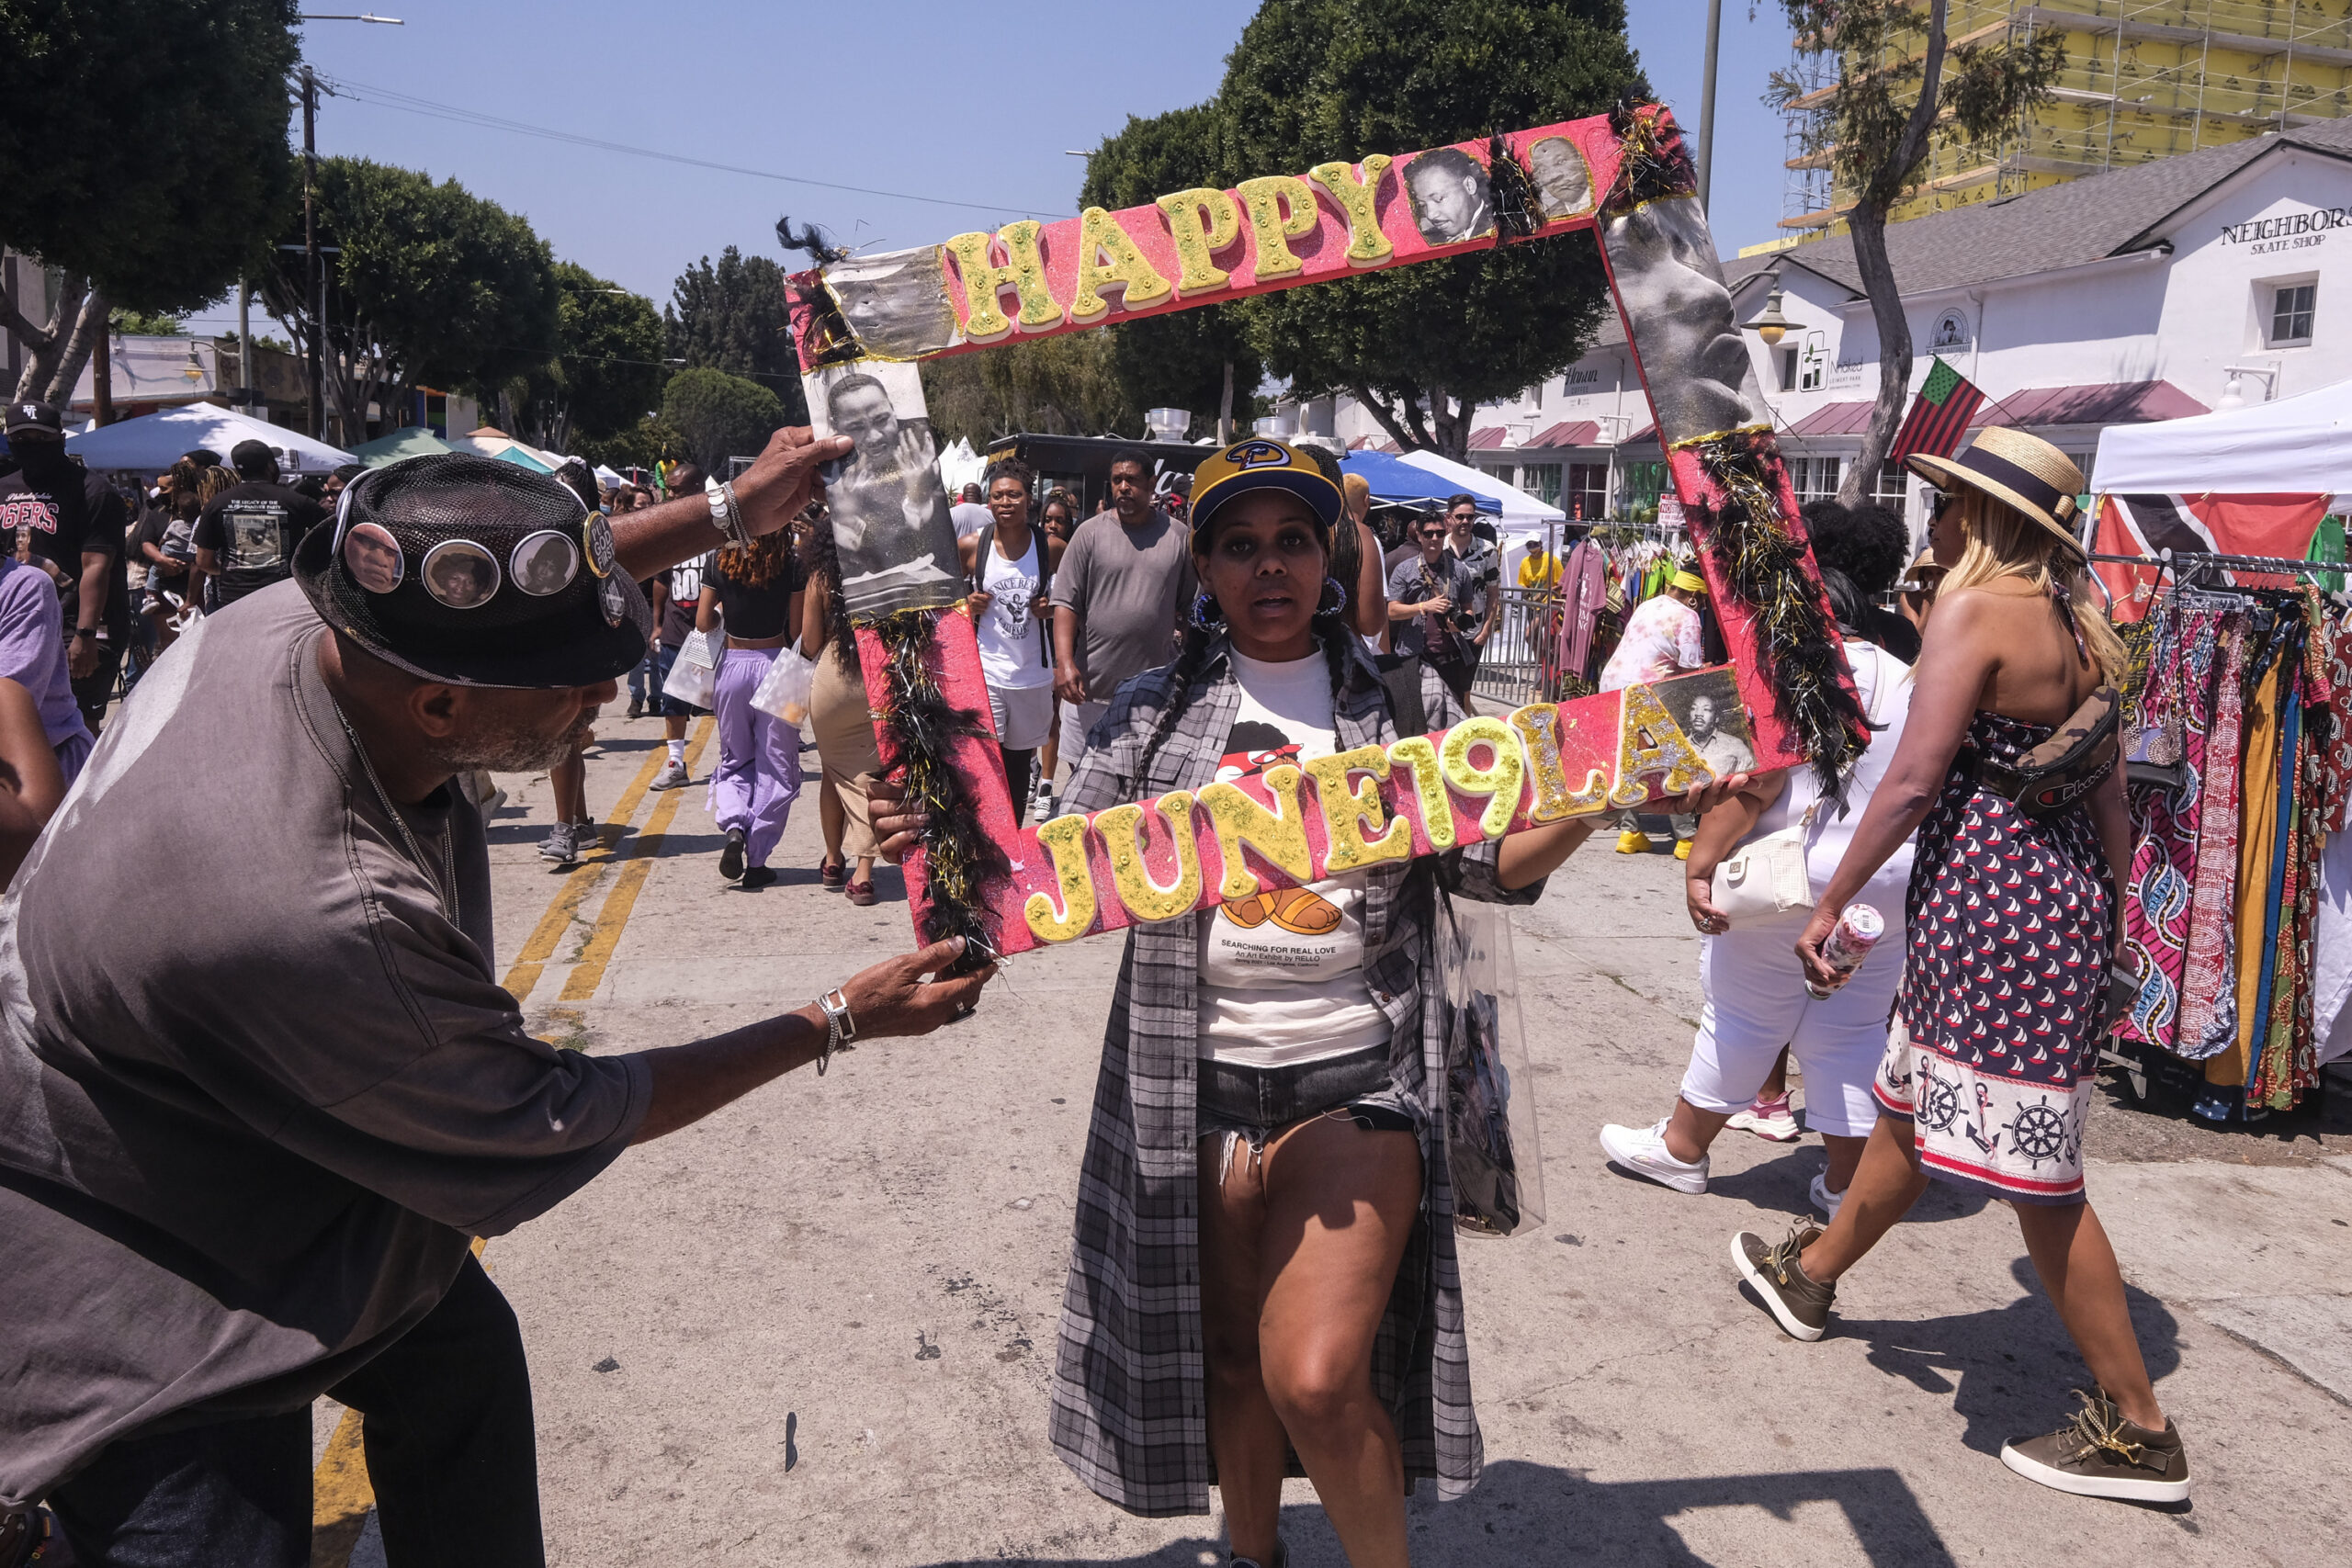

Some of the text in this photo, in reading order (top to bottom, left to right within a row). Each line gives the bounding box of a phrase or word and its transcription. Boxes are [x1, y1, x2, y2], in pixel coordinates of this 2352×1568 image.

[944, 153, 1395, 344] HAPPY
[2250, 234, 2326, 255] SKATE SHOP
[591, 519, 608, 541] PUT
[594, 532, 613, 556] GOD
[597, 544, 615, 571] FIRST
[672, 568, 704, 602] BO
[988, 579, 1015, 595] ENICE
[1221, 939, 1268, 953] SEARCHING
[1315, 946, 1336, 954] LOVE
